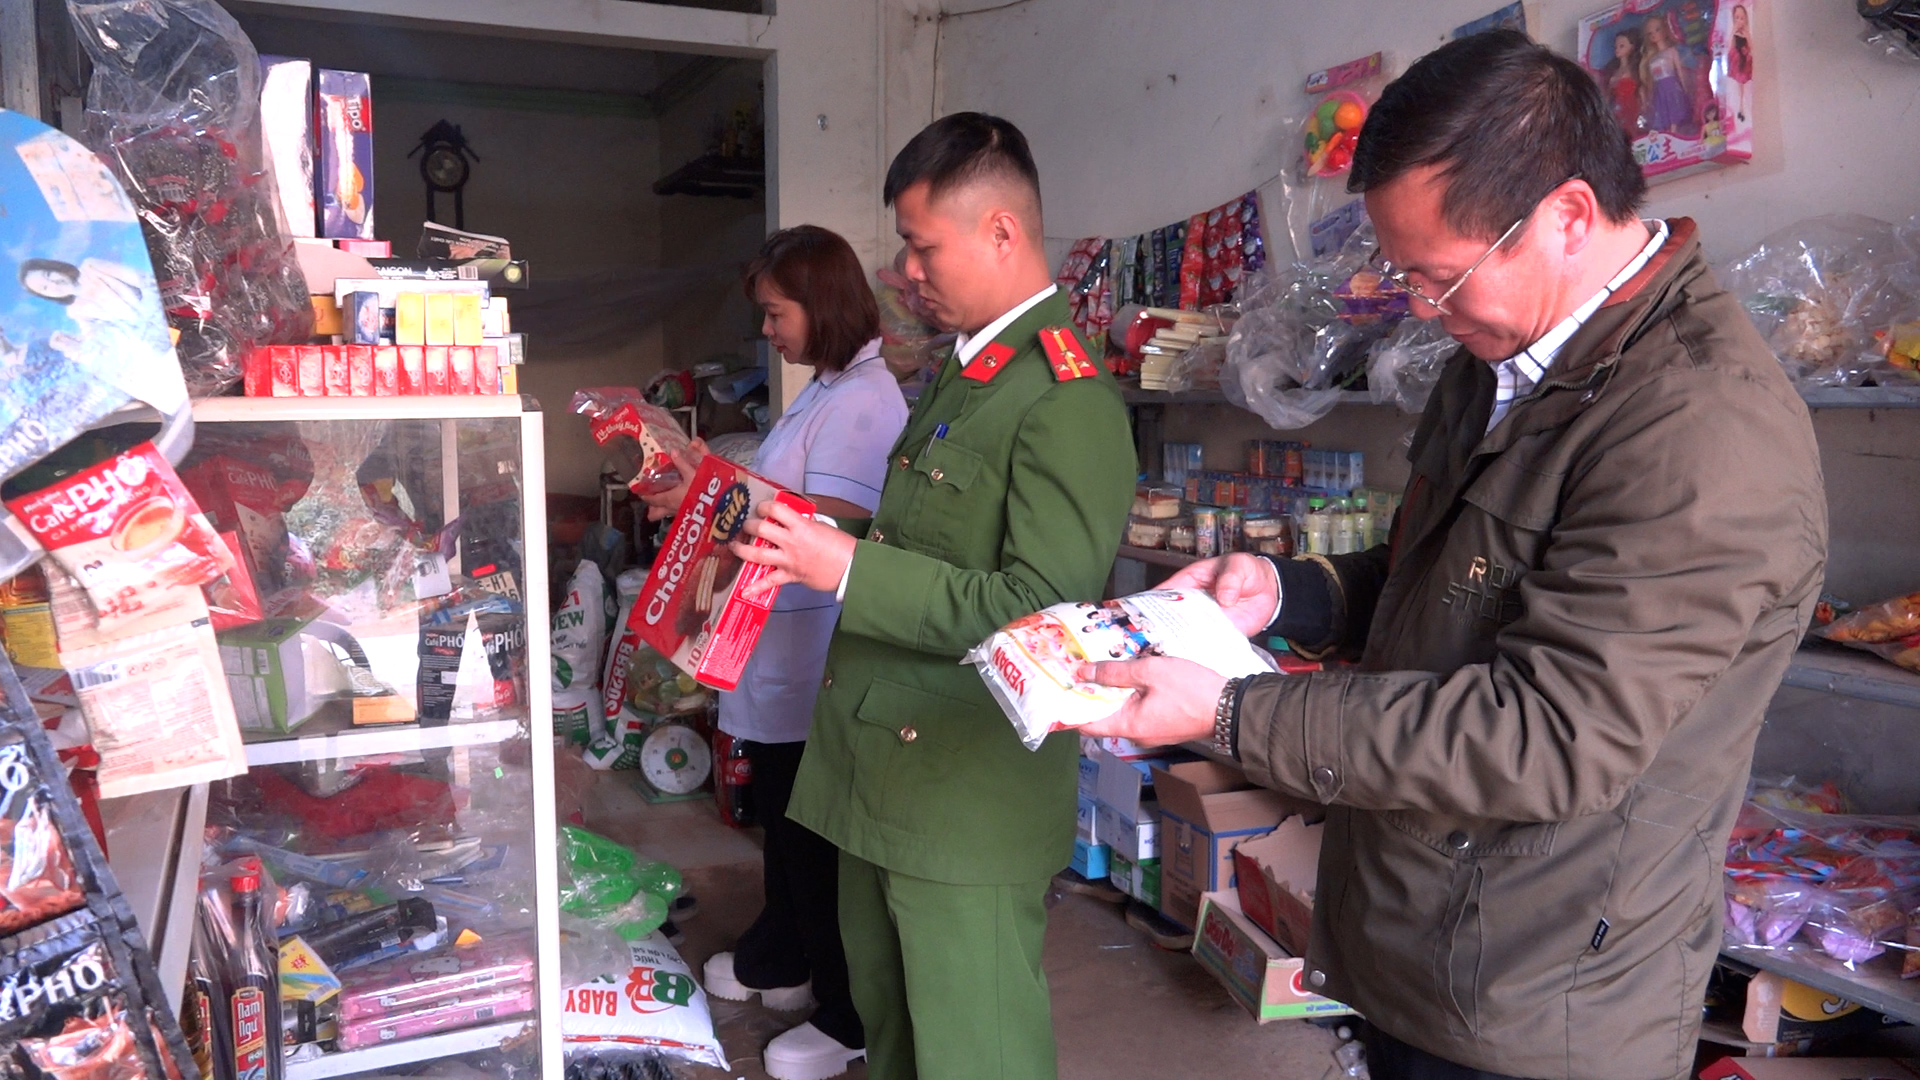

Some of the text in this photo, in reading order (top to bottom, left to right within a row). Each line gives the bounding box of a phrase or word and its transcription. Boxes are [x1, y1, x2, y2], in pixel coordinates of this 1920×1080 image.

[646, 476, 722, 626] ChocoPie
[994, 647, 1025, 697] VEDAN
[565, 990, 618, 1016] BABY
